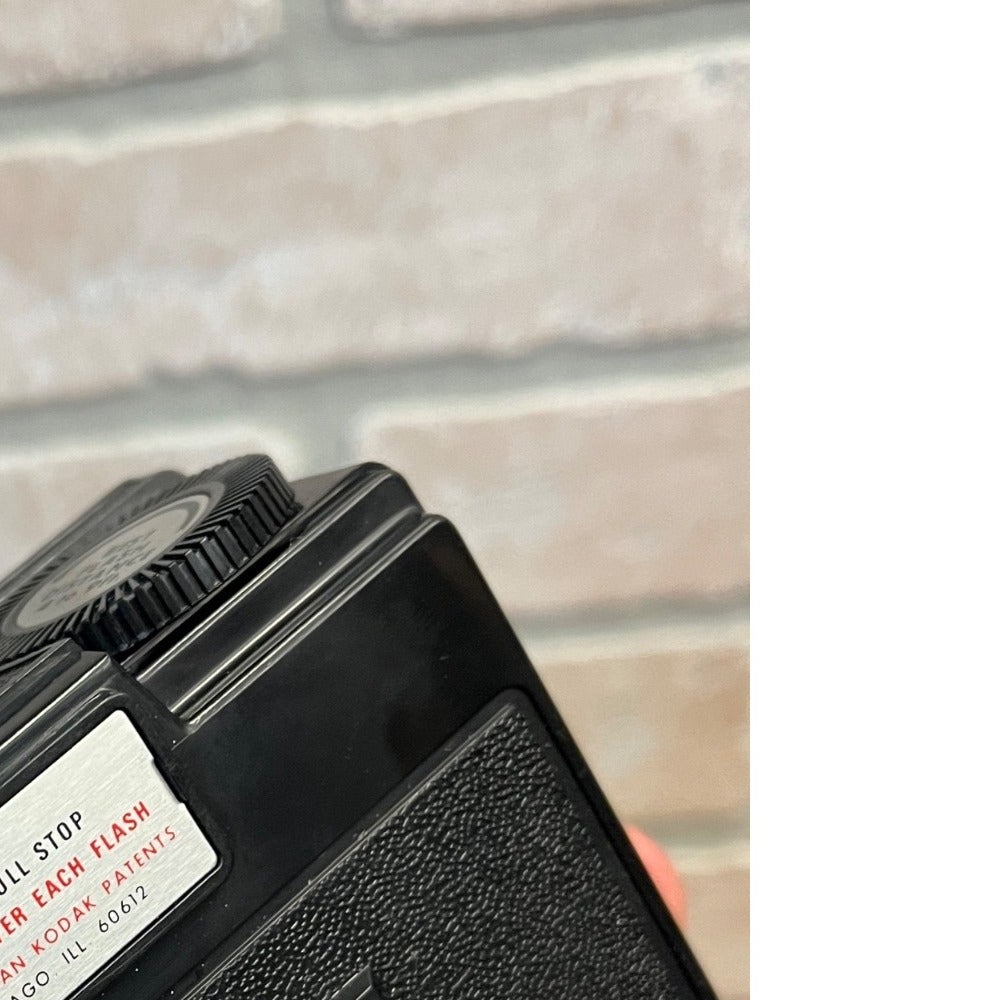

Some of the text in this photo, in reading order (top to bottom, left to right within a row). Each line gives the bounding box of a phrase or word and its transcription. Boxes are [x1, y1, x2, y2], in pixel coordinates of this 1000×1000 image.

[31, 857, 85, 908] EACH
[90, 801, 150, 858] FLASH
[33, 811, 81, 861] STOP
[31, 896, 96, 955] KODAK
[102, 826, 175, 895] PATENTS
[99, 886, 148, 933] 60612
